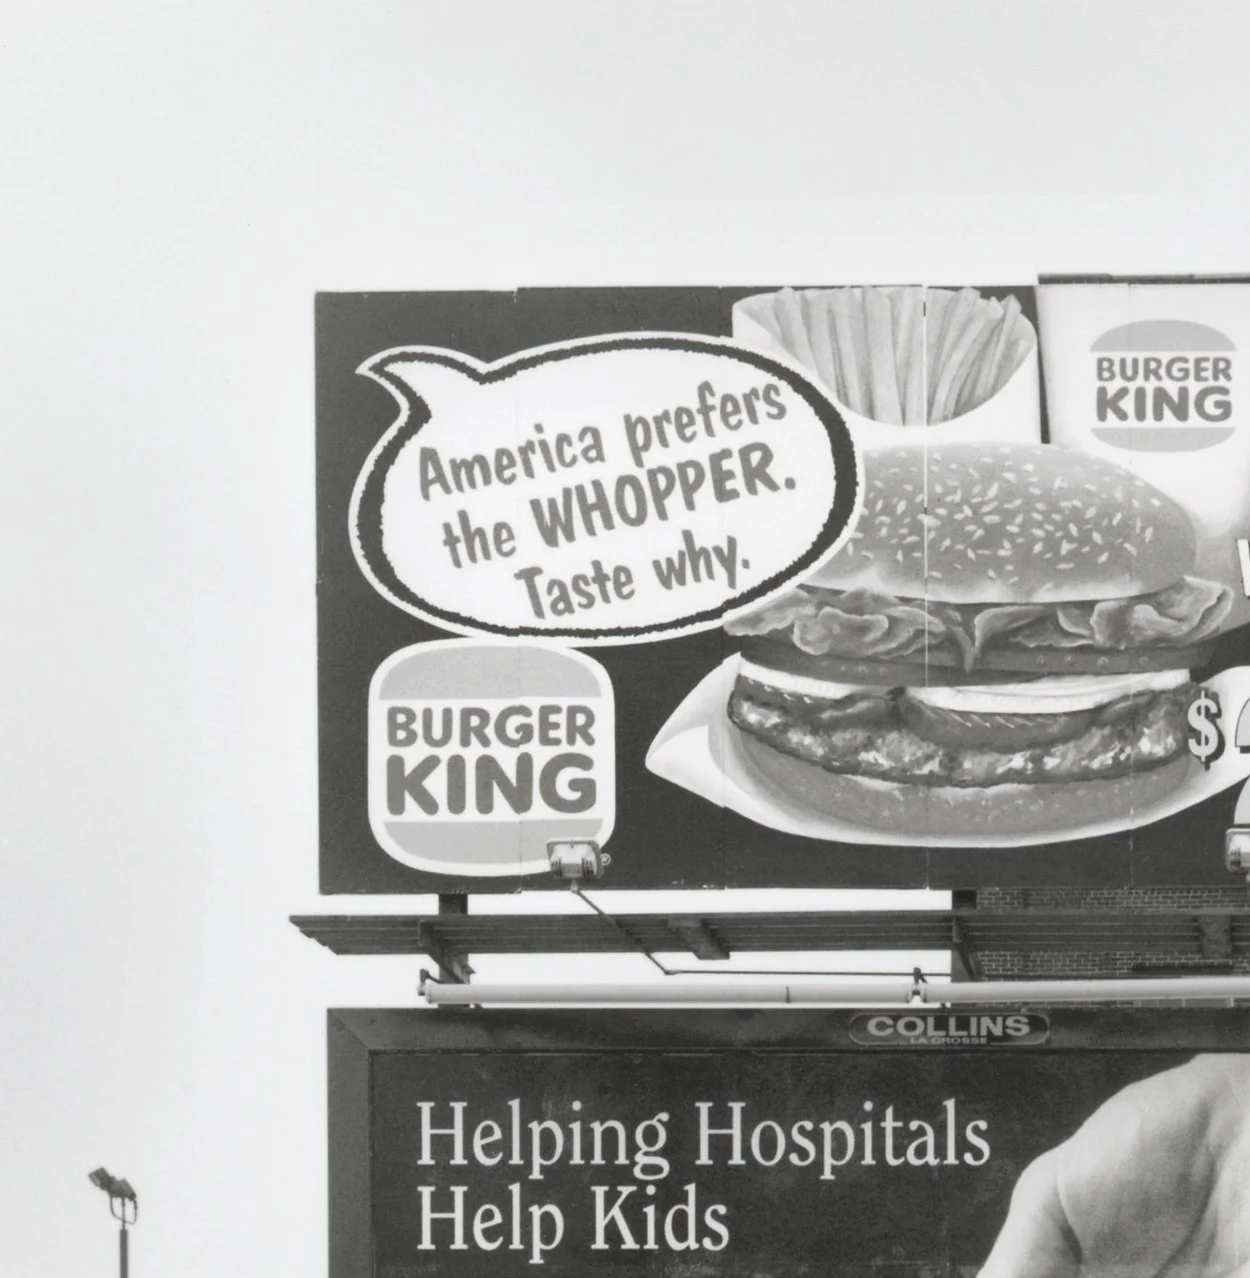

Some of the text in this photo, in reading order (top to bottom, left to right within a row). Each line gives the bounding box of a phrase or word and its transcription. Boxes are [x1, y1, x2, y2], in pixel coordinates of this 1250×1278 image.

[1096, 356, 1233, 383] BURGER
[1096, 385, 1233, 423] KING
[418, 380, 788, 502] America prefers
[442, 441, 797, 569] the WHOPPER.
[514, 529, 751, 620] Taste why.
[386, 704, 597, 749] BURGER
[386, 751, 598, 817] KING
[867, 1016, 1031, 1037] COLLINS
[416, 1098, 992, 1180] Helping Hospitals
[416, 1183, 731, 1264] Help Kids
